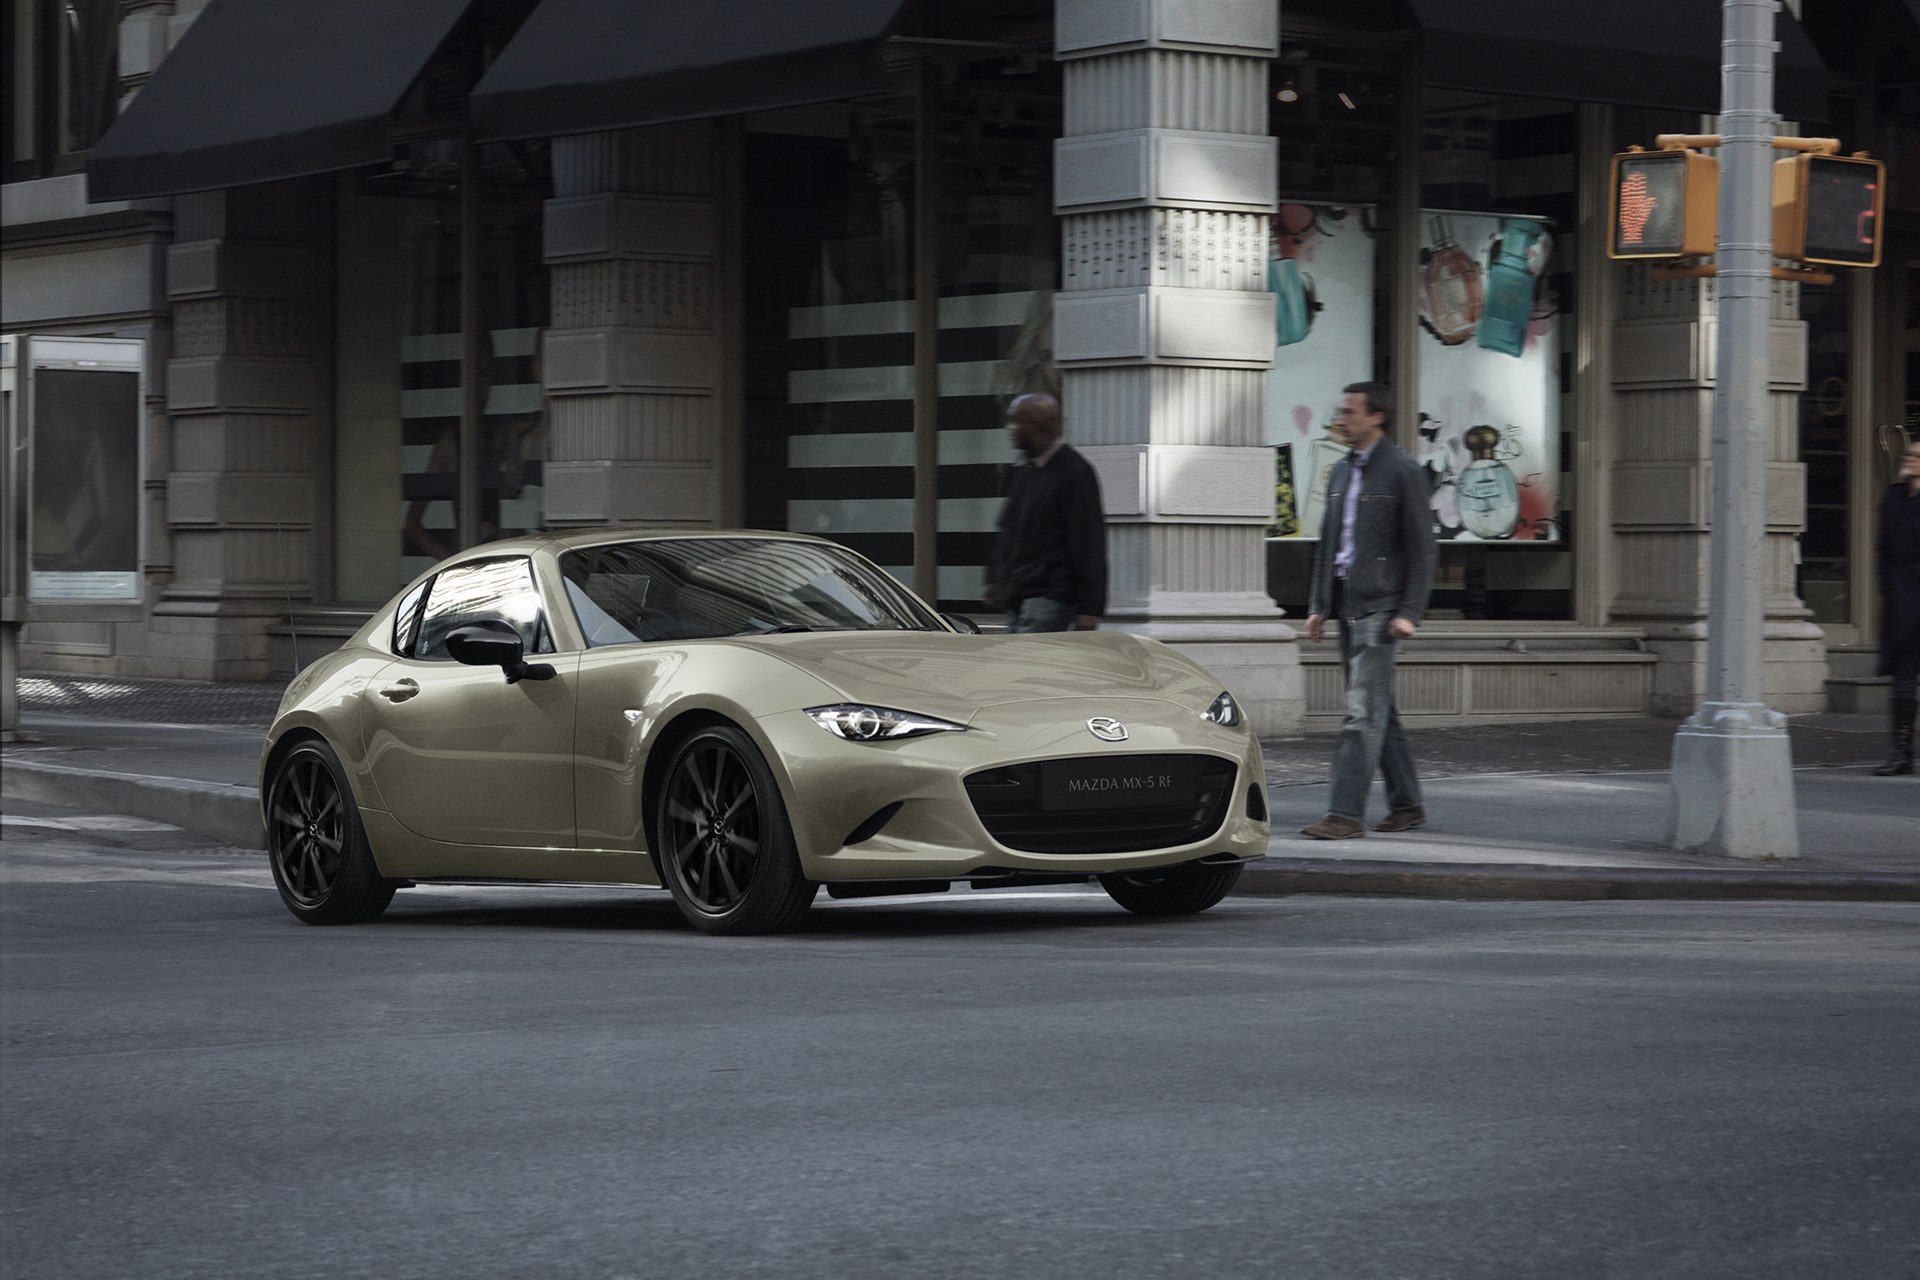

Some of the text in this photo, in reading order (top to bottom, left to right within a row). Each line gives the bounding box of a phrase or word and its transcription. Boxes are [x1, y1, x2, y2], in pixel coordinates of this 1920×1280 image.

[1068, 774, 1172, 792] MAZDA MX-5 RF
